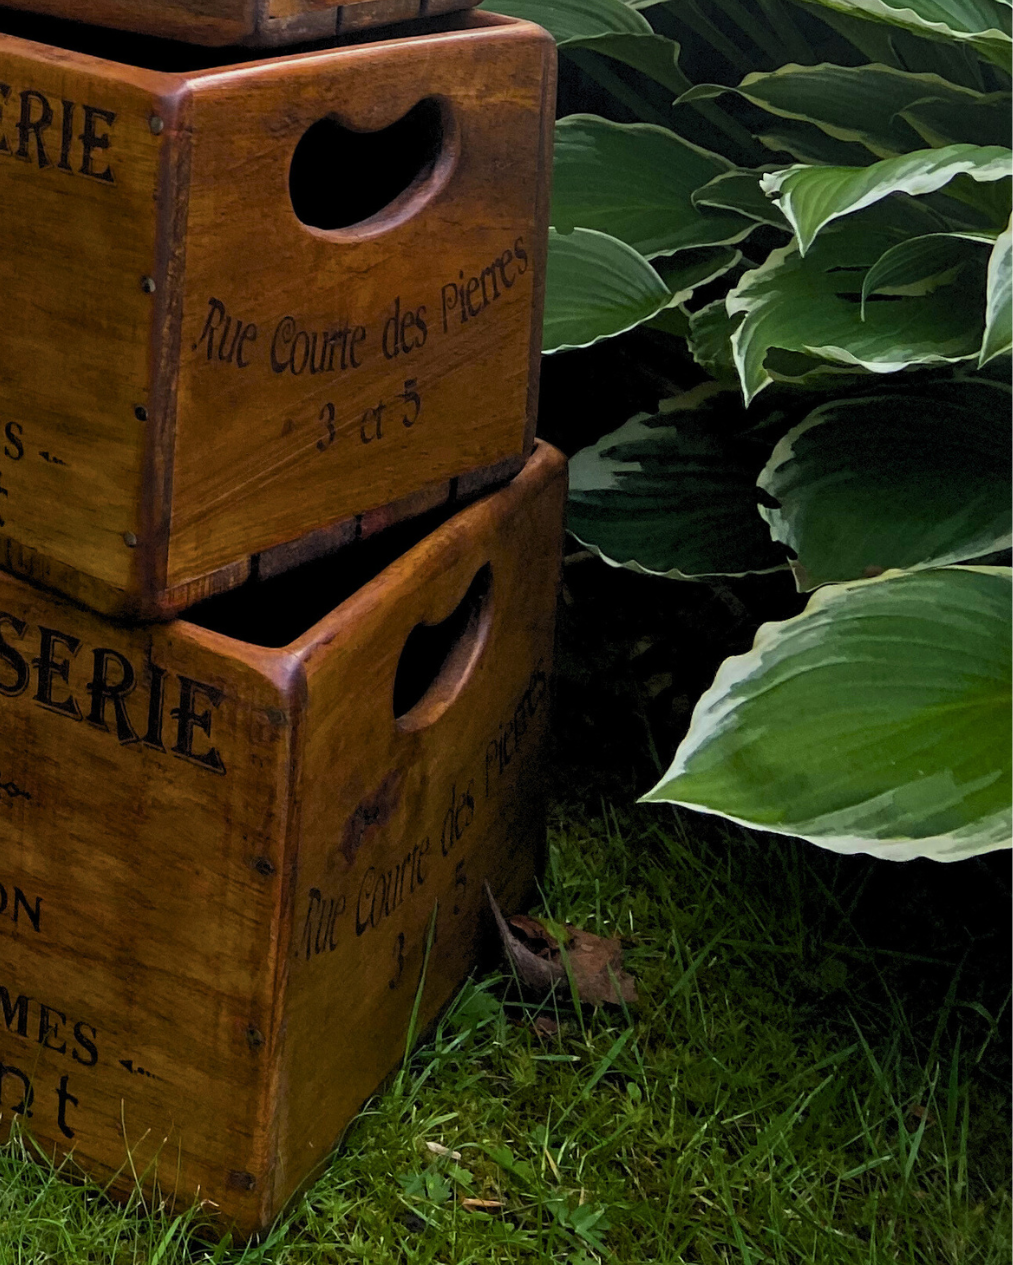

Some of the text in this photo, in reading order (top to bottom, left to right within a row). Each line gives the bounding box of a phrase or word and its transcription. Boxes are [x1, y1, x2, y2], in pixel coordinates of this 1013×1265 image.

[192, 235, 531, 376] Rue Courte des Pierres
[315, 377, 422, 453] 3 et 5
